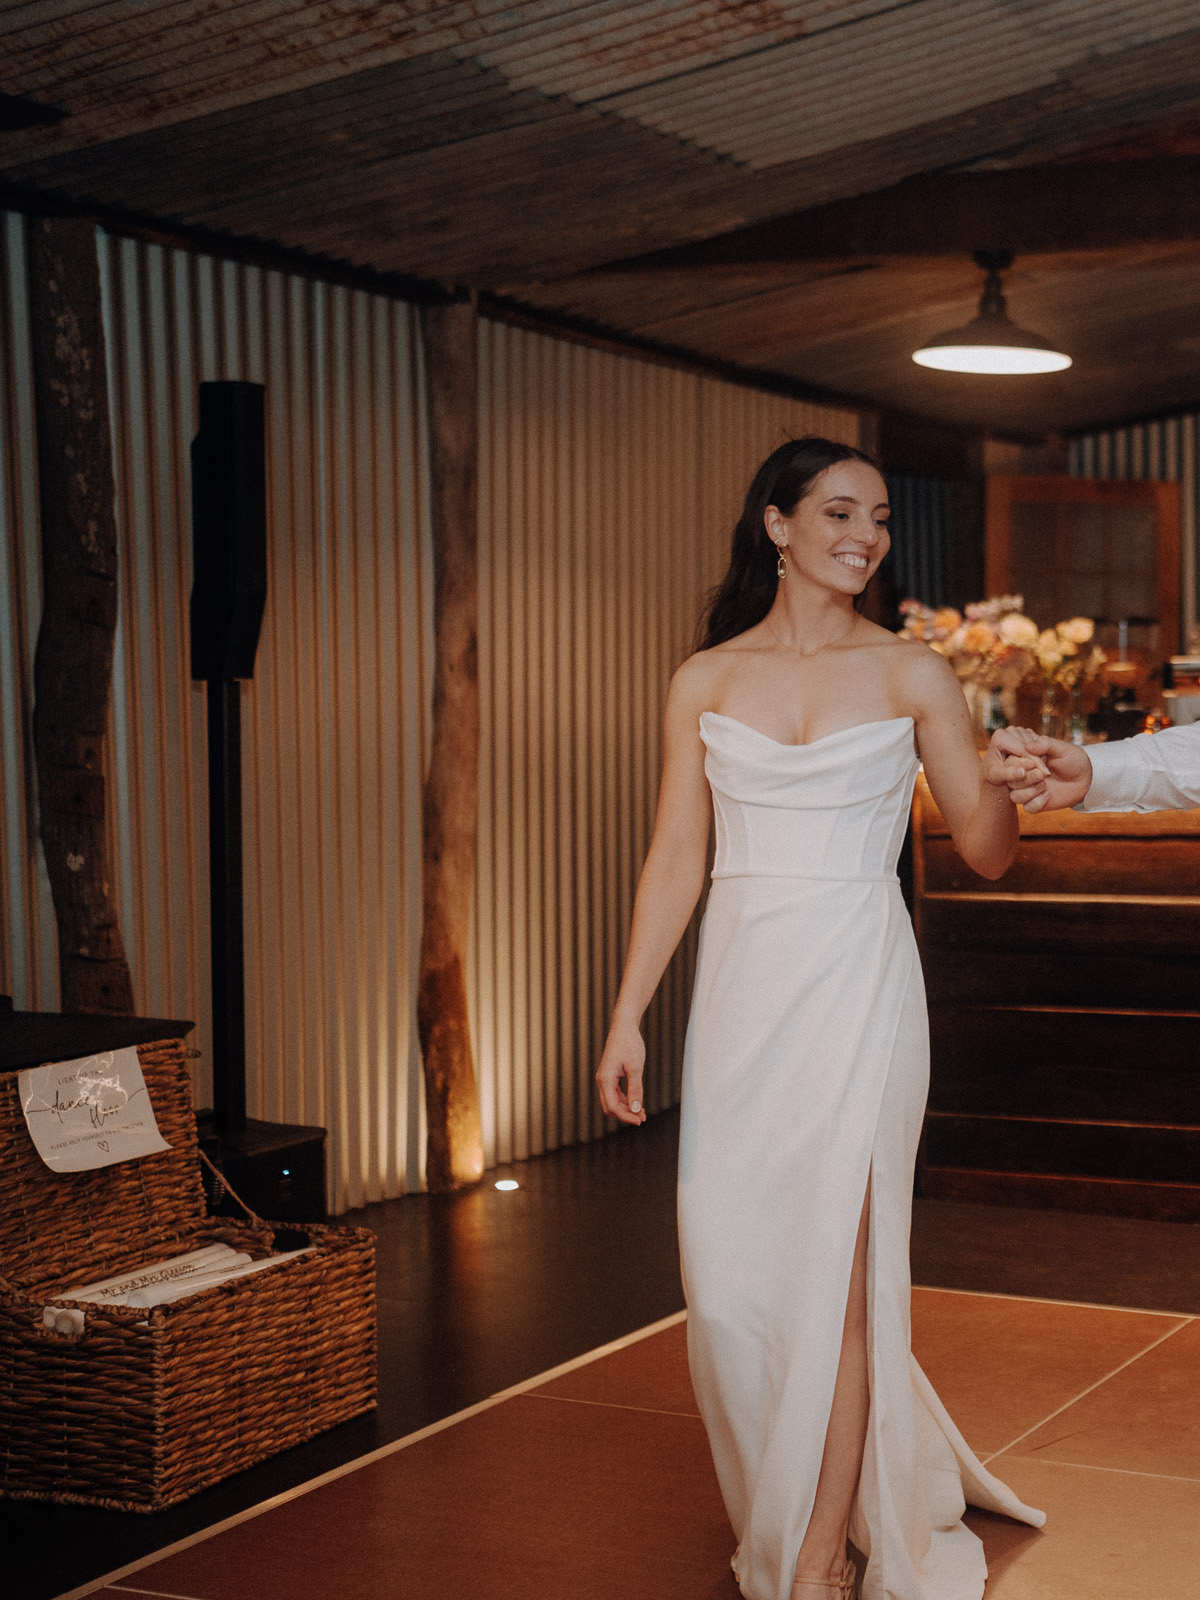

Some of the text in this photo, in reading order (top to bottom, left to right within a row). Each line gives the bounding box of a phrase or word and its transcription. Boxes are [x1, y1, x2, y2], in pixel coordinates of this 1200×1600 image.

[57, 1075, 77, 1085] LIGHT
[51, 1090, 89, 1124] dance
[50, 1141, 68, 1151] PLEASE
[100, 1288, 116, 1298] Mr
[120, 1279, 139, 1291] and
[140, 1274, 159, 1286] Mrs
